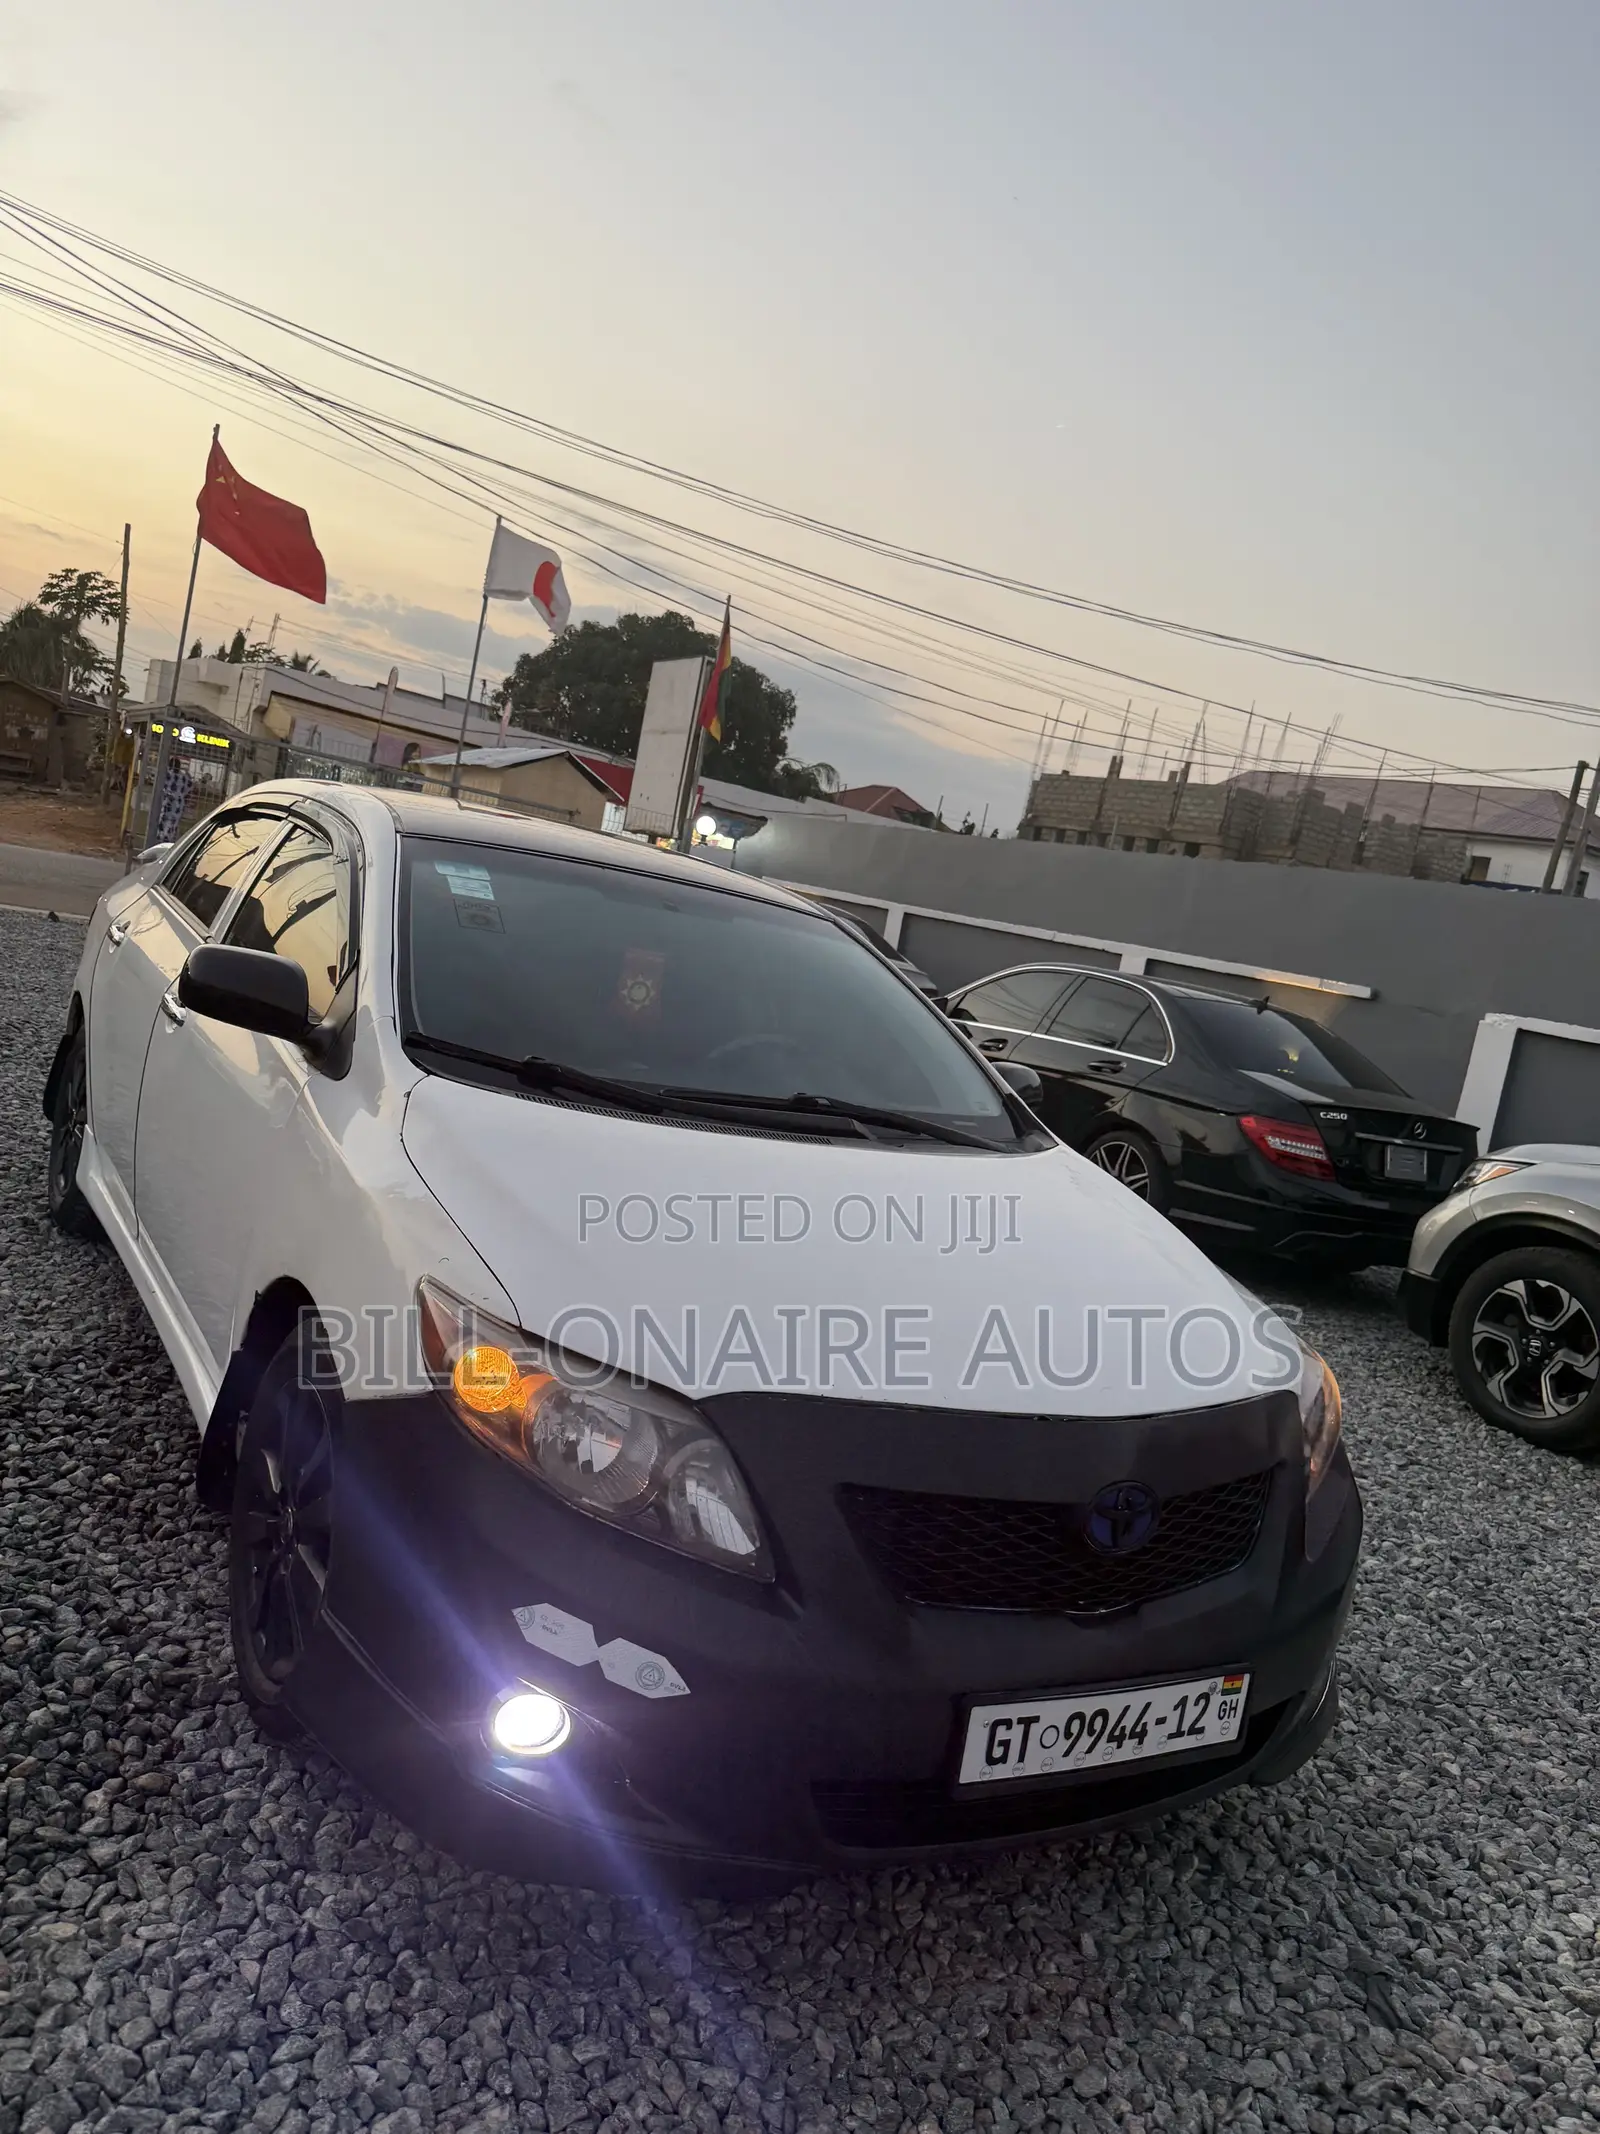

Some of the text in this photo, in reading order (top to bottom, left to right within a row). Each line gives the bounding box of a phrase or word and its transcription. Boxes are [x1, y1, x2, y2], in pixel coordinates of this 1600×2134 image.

[1319, 1111, 1348, 1121] C250
[1217, 1698, 1239, 1721] GH
[985, 1692, 1211, 1766] GT 9944-12
